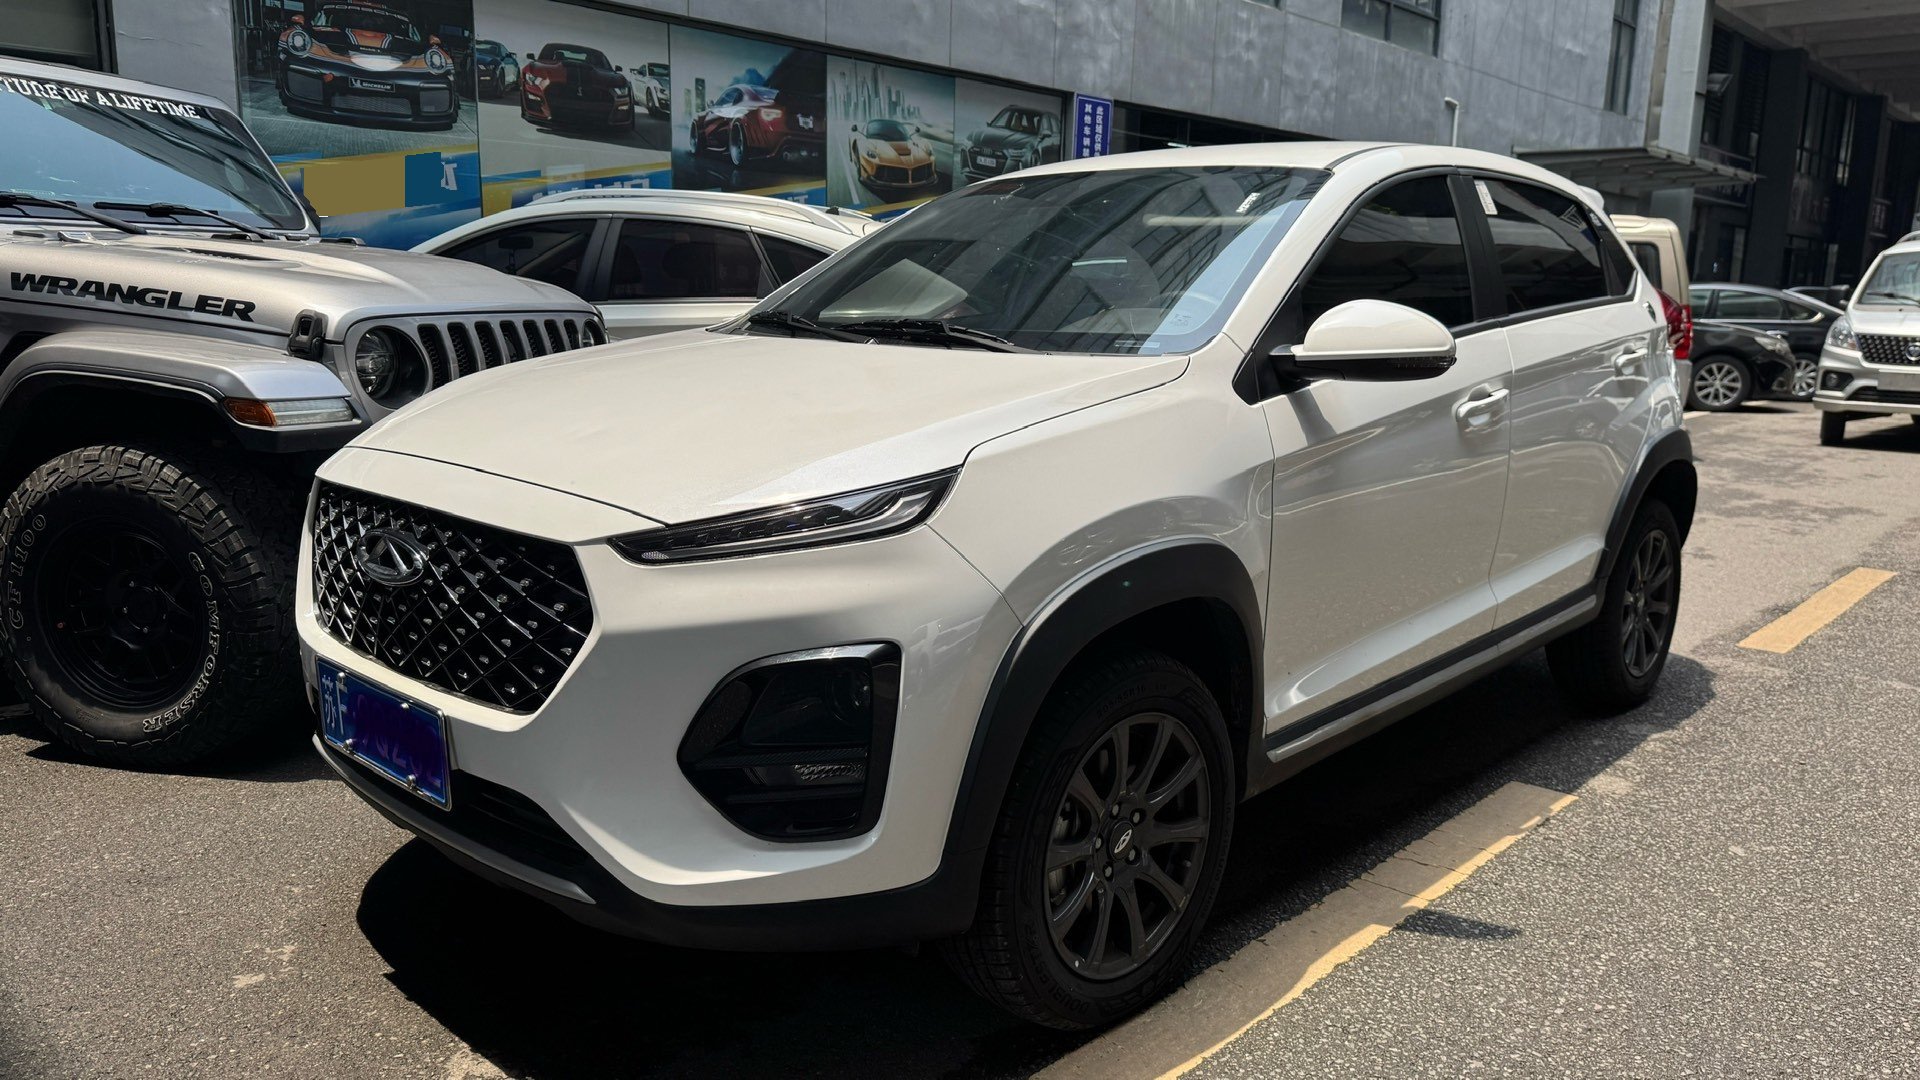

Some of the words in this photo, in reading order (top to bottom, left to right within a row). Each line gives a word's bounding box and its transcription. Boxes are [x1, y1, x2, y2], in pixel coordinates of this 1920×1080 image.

[0, 76, 64, 101] TURE
[63, 86, 90, 104] OF
[96, 91, 113, 106] A
[108, 92, 201, 119] LIFETIME
[10, 271, 256, 322] WRANGLER
[143, 551, 221, 733] COMFORSER
